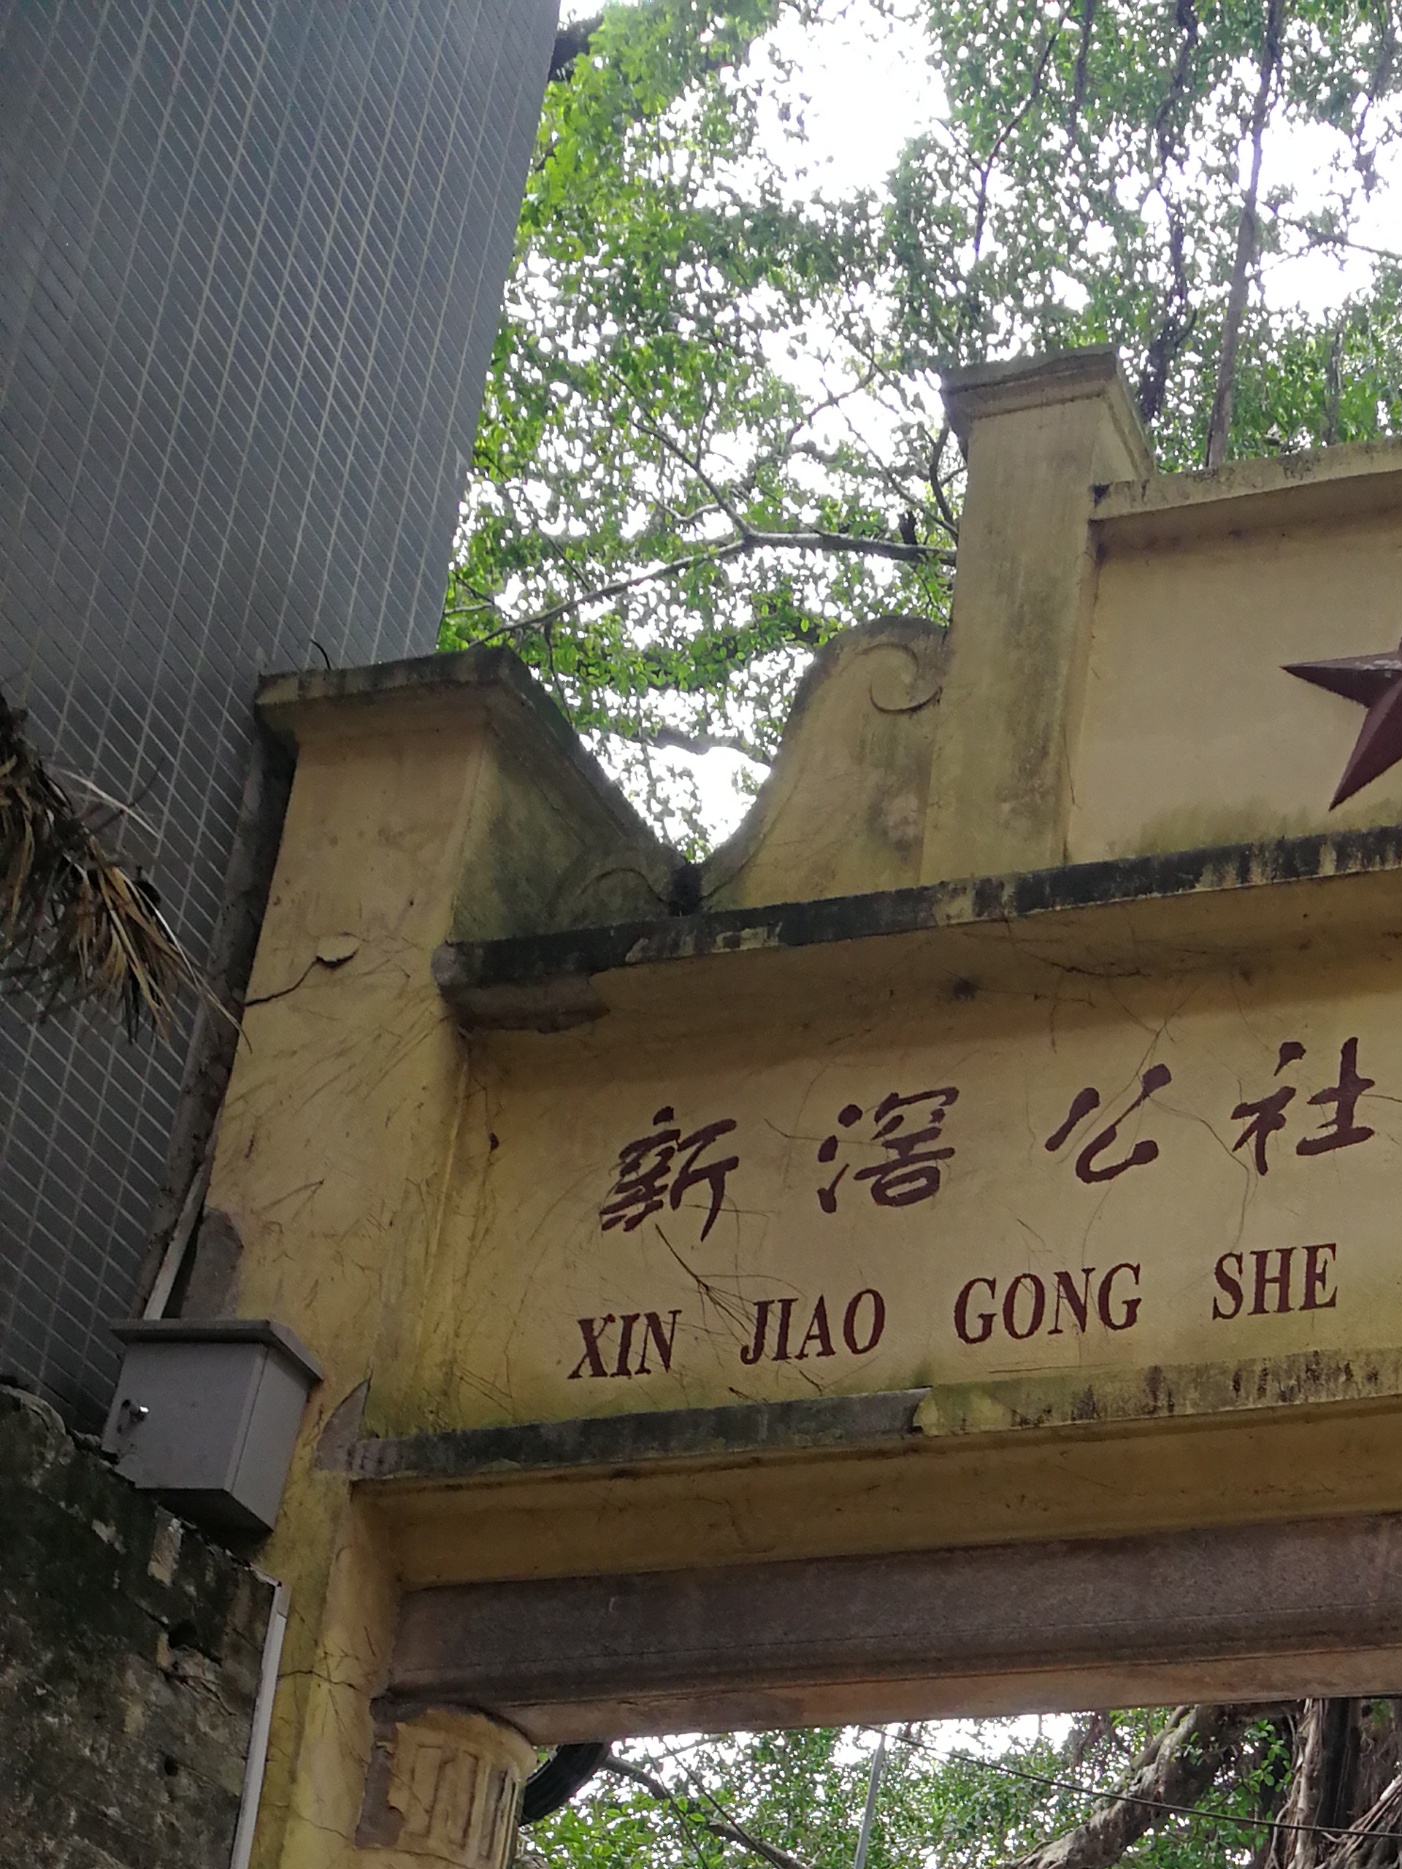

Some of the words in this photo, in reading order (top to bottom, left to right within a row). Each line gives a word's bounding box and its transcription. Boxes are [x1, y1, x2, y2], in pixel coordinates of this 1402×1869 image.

[567, 1308, 682, 1381] XIN
[739, 1286, 887, 1367] JIAO
[953, 1261, 1143, 1345] GONG
[1211, 1241, 1339, 1321] SHE
